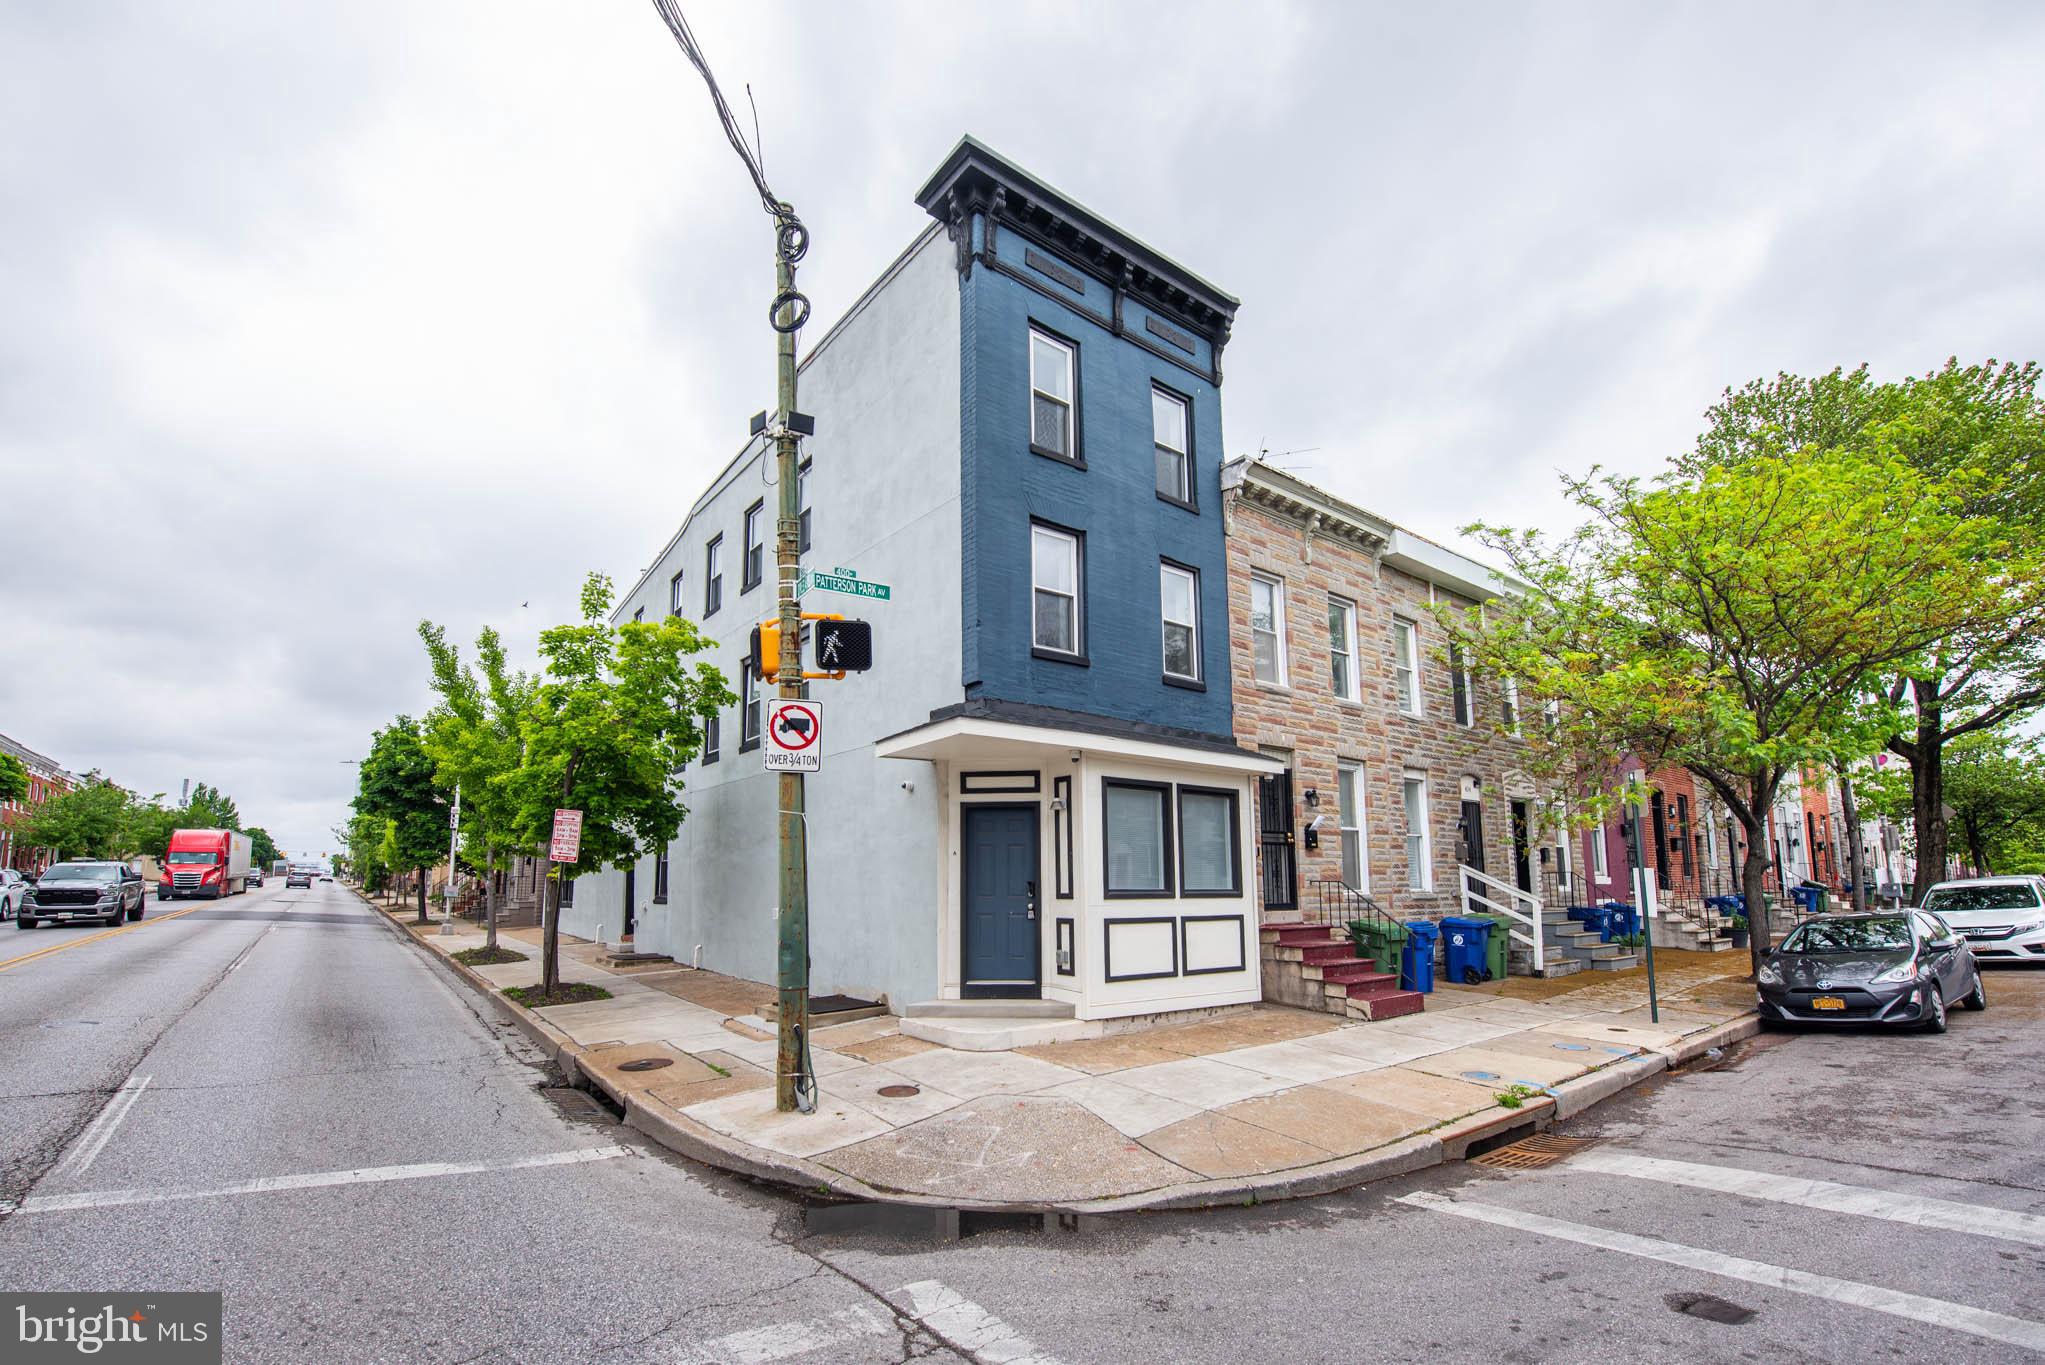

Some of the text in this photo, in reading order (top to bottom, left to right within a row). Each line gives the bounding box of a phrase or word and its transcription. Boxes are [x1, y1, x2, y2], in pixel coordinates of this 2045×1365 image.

[816, 575, 856, 592] PATTERSON
[858, 583, 877, 596] PARK
[769, 752, 818, 767] OVER 3/4 TON
